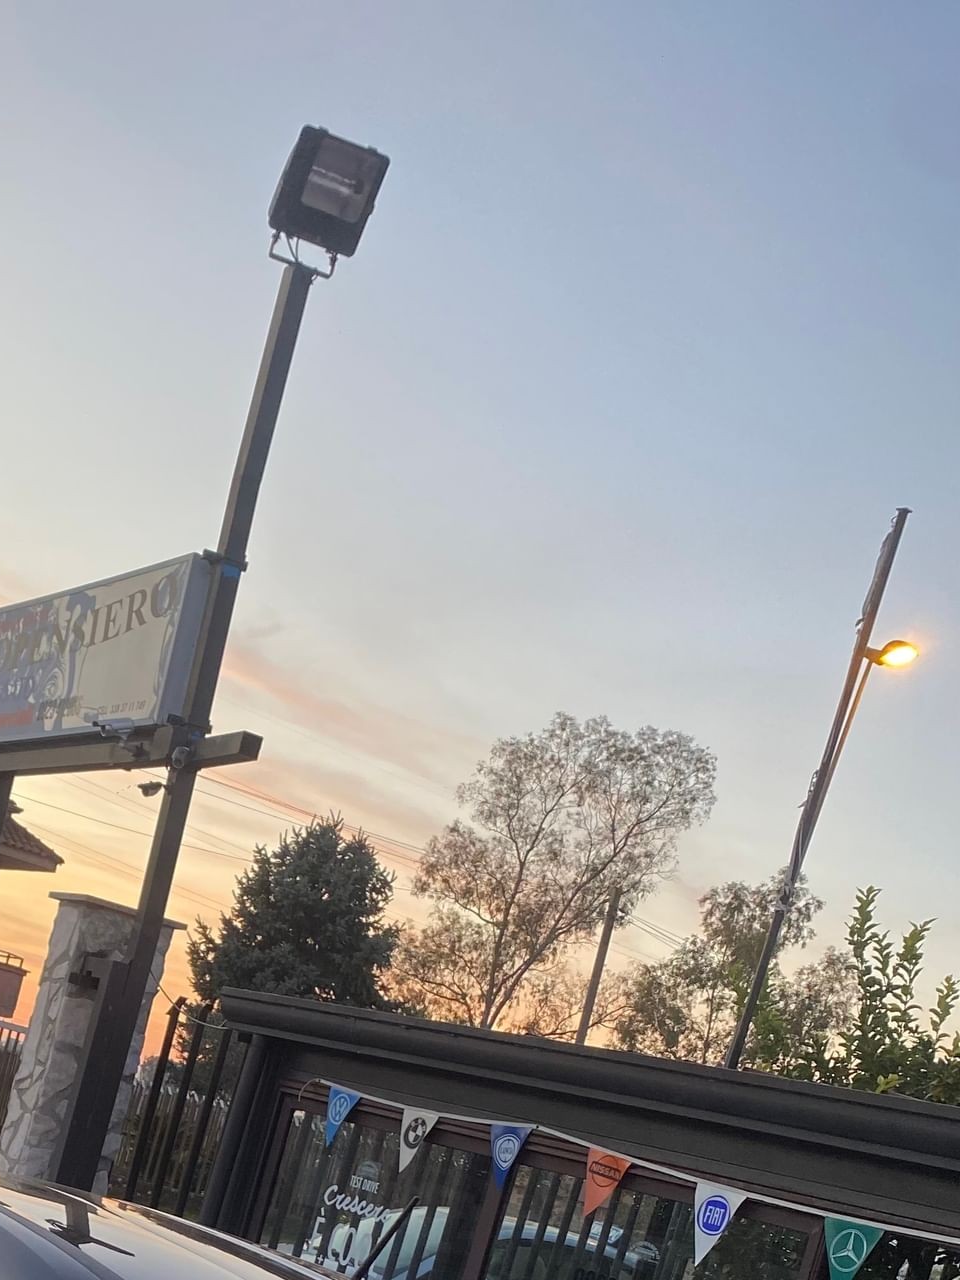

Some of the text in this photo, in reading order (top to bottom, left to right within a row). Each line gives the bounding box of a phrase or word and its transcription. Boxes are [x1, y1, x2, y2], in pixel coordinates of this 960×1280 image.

[591, 1162, 620, 1180] NISSAN
[350, 1175, 380, 1194] TEST DRIVE
[704, 1205, 726, 1227] FIAT
